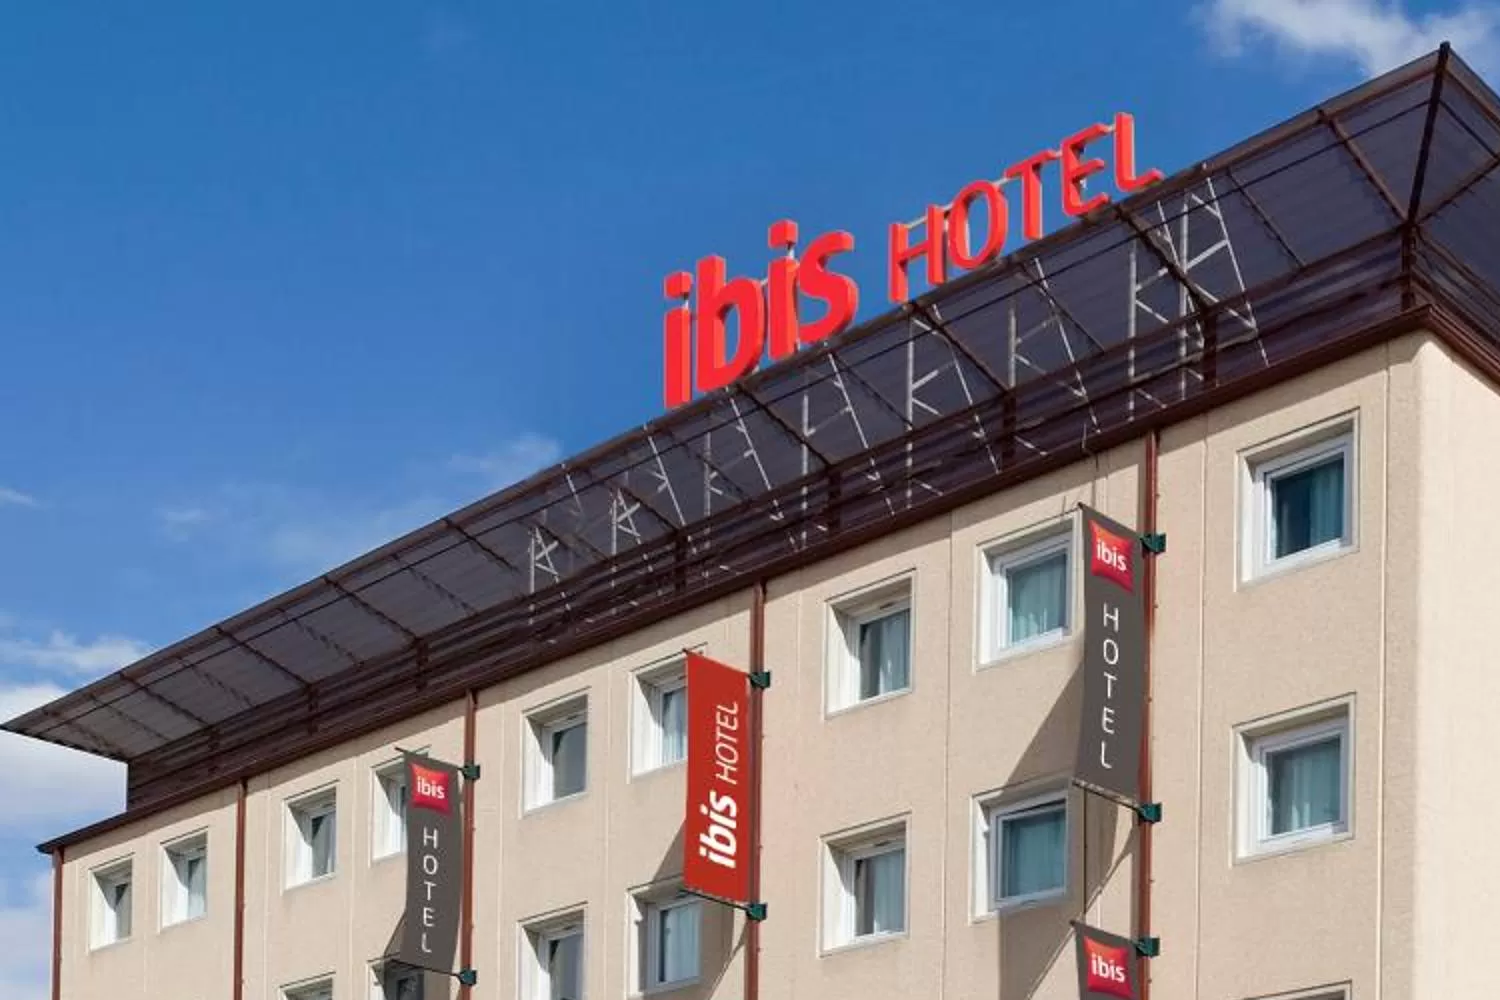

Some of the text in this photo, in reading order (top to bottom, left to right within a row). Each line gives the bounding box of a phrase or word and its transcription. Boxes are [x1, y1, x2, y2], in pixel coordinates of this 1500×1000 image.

[663, 111, 1163, 411] ibis HOTEL
[1095, 539, 1128, 573] ibis
[1100, 602, 1120, 769] HOTEL
[416, 775, 446, 800] ibis
[698, 700, 740, 869] ibis HOTEL
[420, 826, 439, 953] HOTEL
[1090, 951, 1126, 984] ibis
